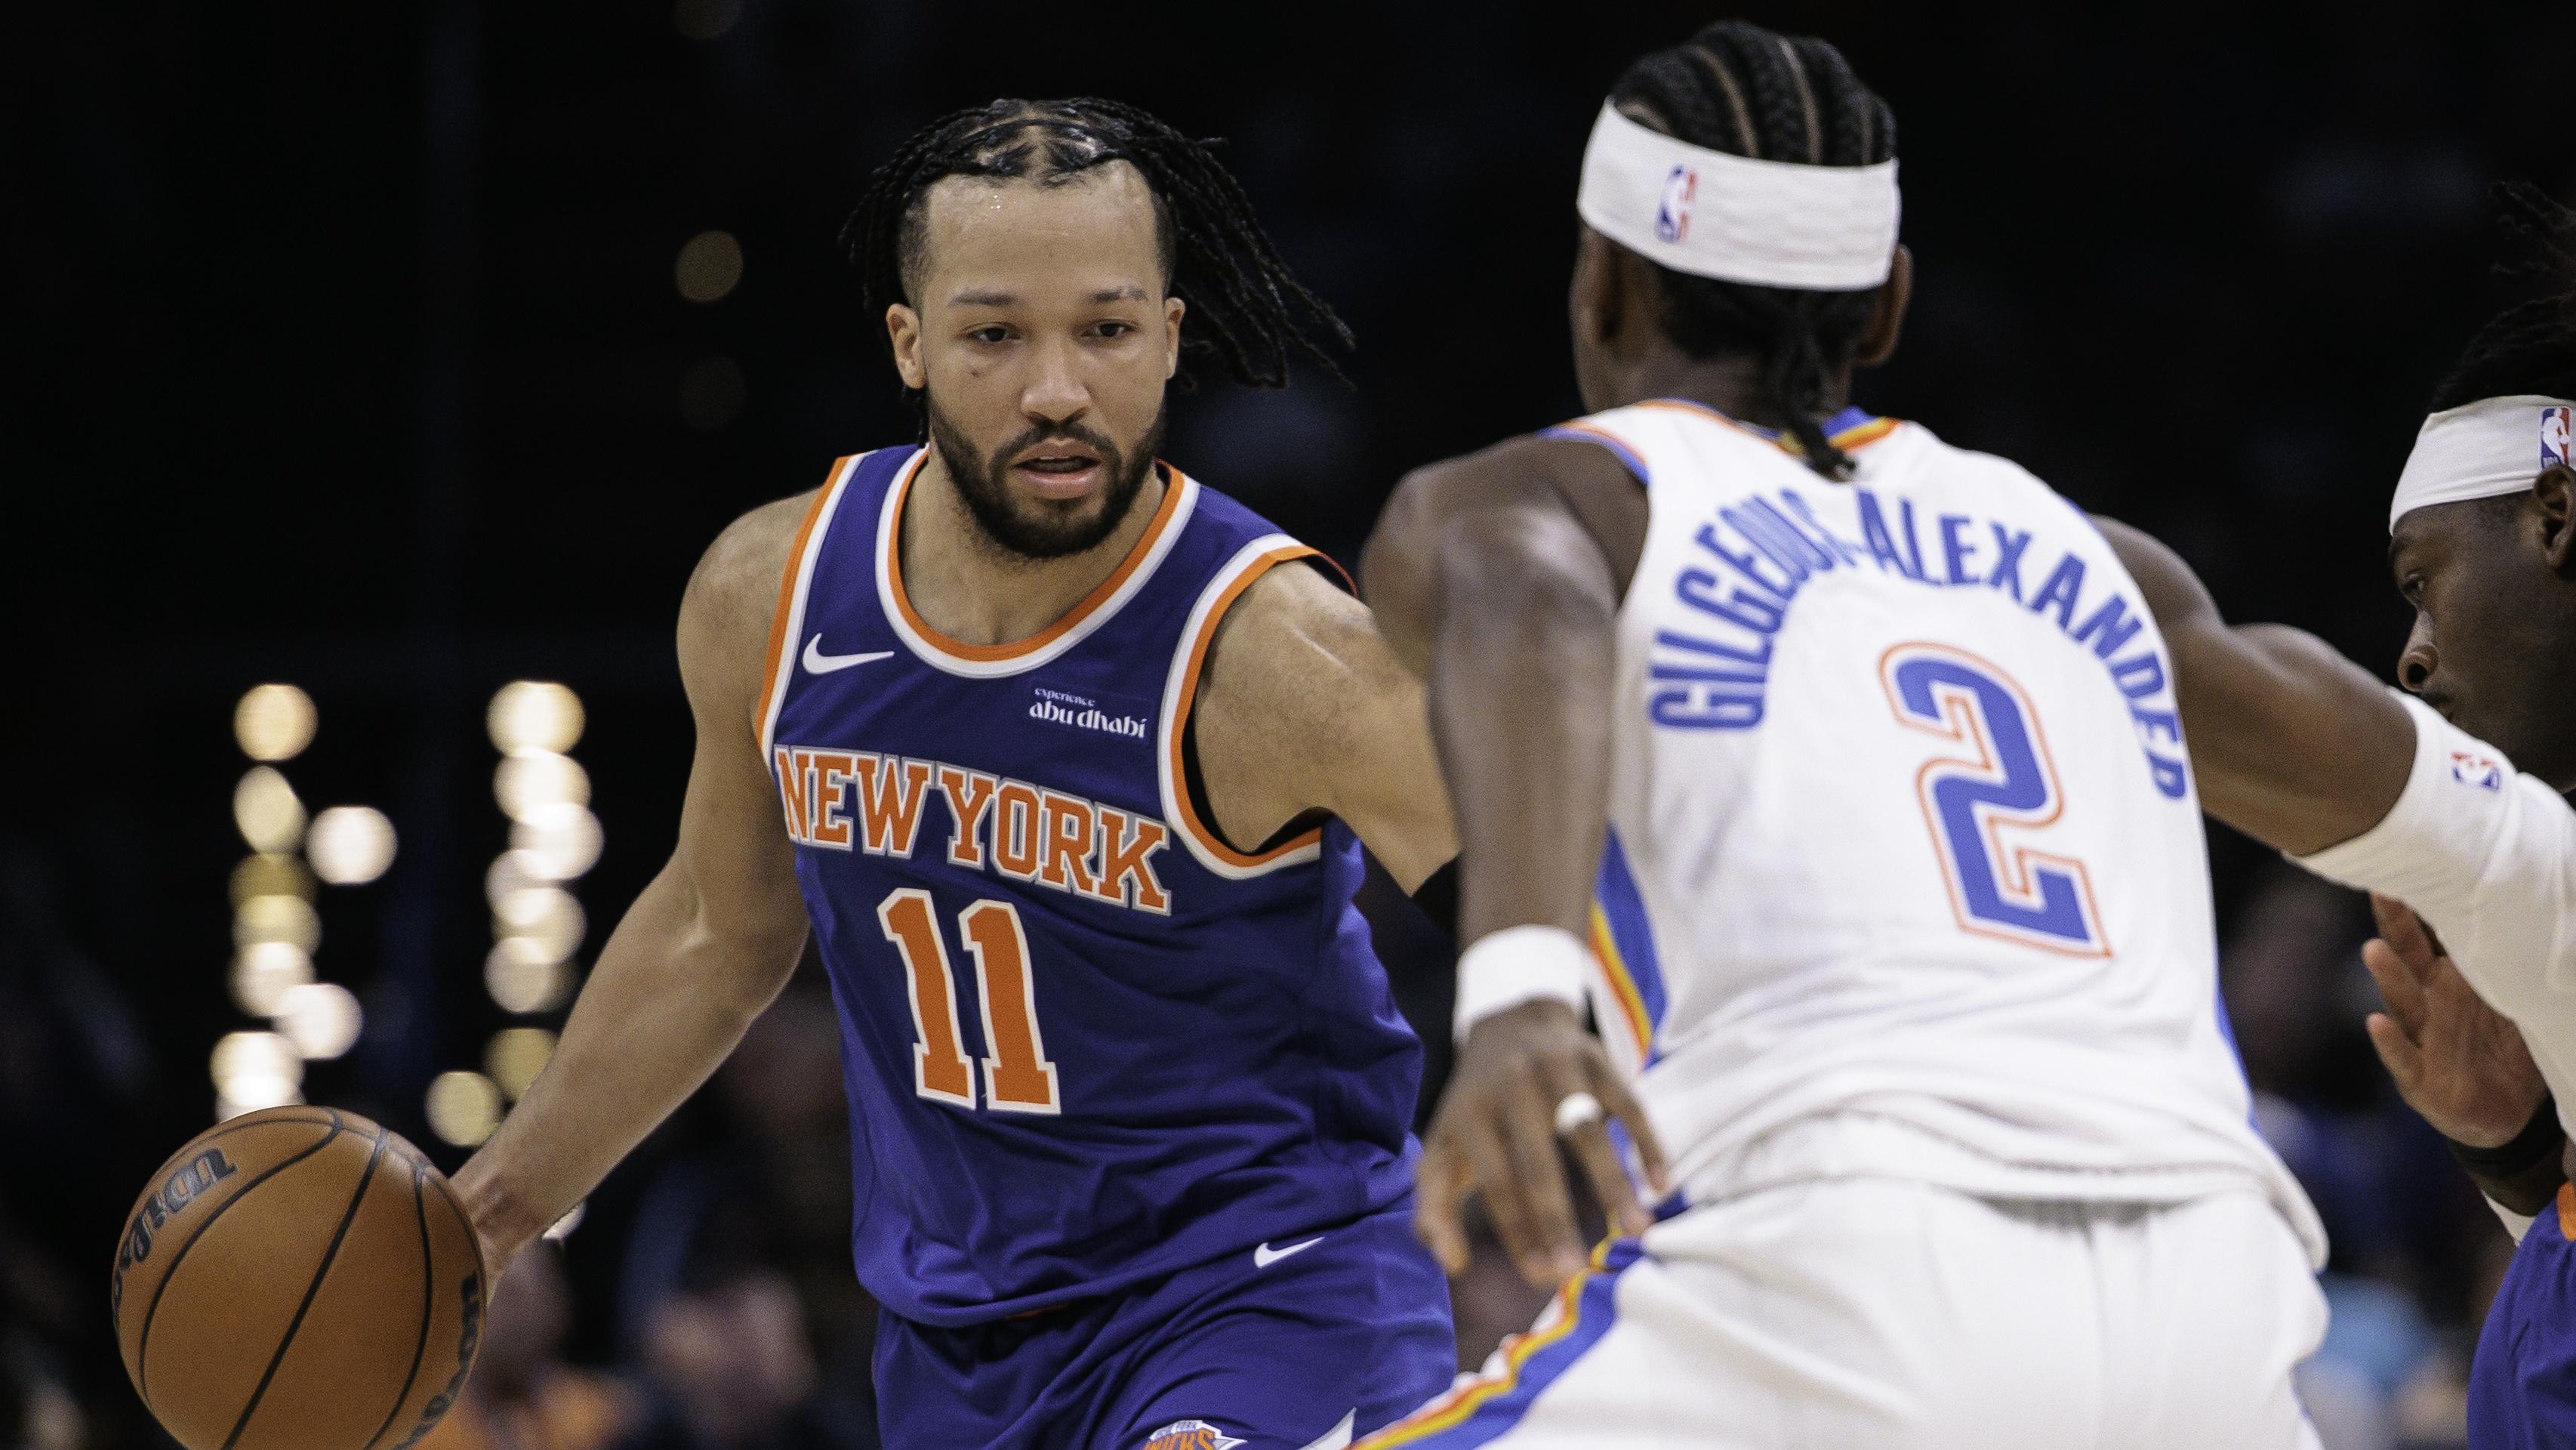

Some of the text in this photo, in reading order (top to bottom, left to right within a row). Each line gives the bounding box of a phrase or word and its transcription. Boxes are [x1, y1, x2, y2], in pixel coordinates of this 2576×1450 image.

[1029, 701, 1148, 739] abu dhabi
[1034, 688, 1095, 707] experience
[774, 745, 1172, 916] NEW YORK
[1878, 640, 2113, 959] 2
[877, 887, 1061, 1114] 11
[112, 1147, 239, 1318] Wils
